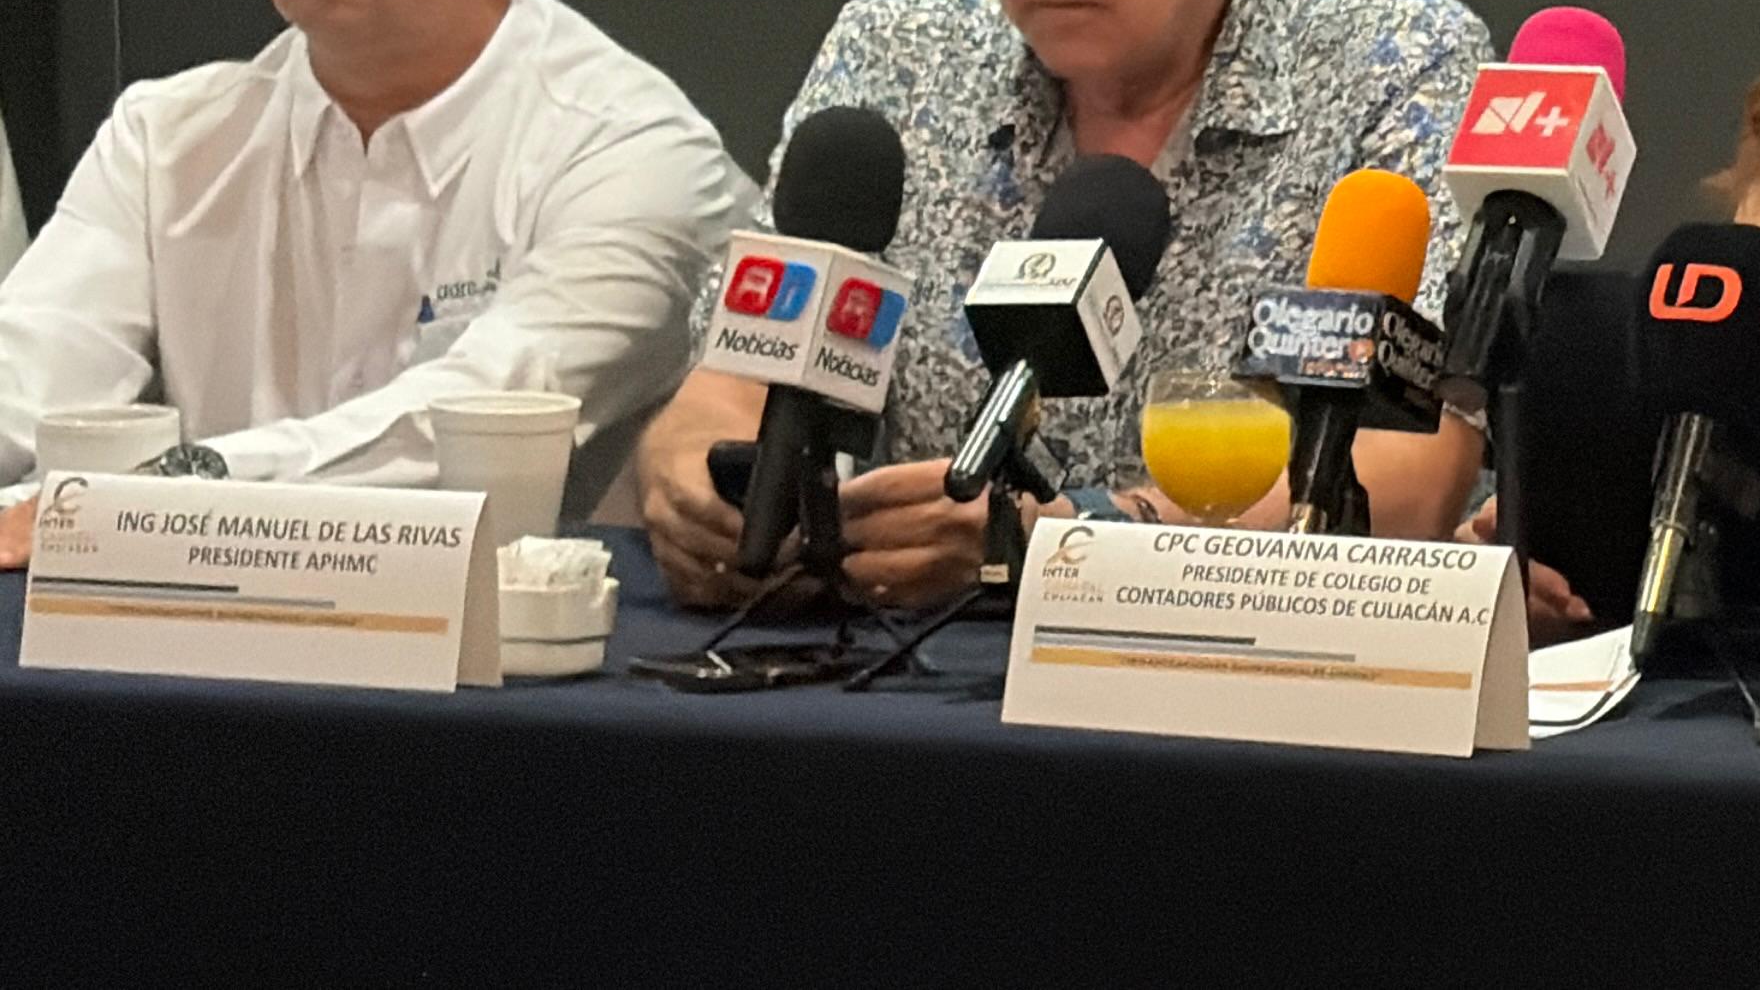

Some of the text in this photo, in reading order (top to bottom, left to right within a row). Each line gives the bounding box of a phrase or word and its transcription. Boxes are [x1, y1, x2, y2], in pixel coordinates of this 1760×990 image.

[715, 327, 800, 361] Noticias
[814, 345, 881, 387] Noticias
[117, 509, 462, 548] ING JOSÉ MANUEL DE LAS RIVAS
[188, 545, 379, 575] PRESIDENTE APHMC
[1153, 531, 1477, 571] CPC GEOVANNA CARRASCO
[1182, 563, 1432, 595] PRESIDENTE DE COLEGIO DE
[1116, 586, 1235, 611] CONTADORES
[1240, 590, 1328, 616] PÚBLICOS
[1332, 598, 1357, 617] DE
[1361, 600, 1454, 623] CULIACÁN
